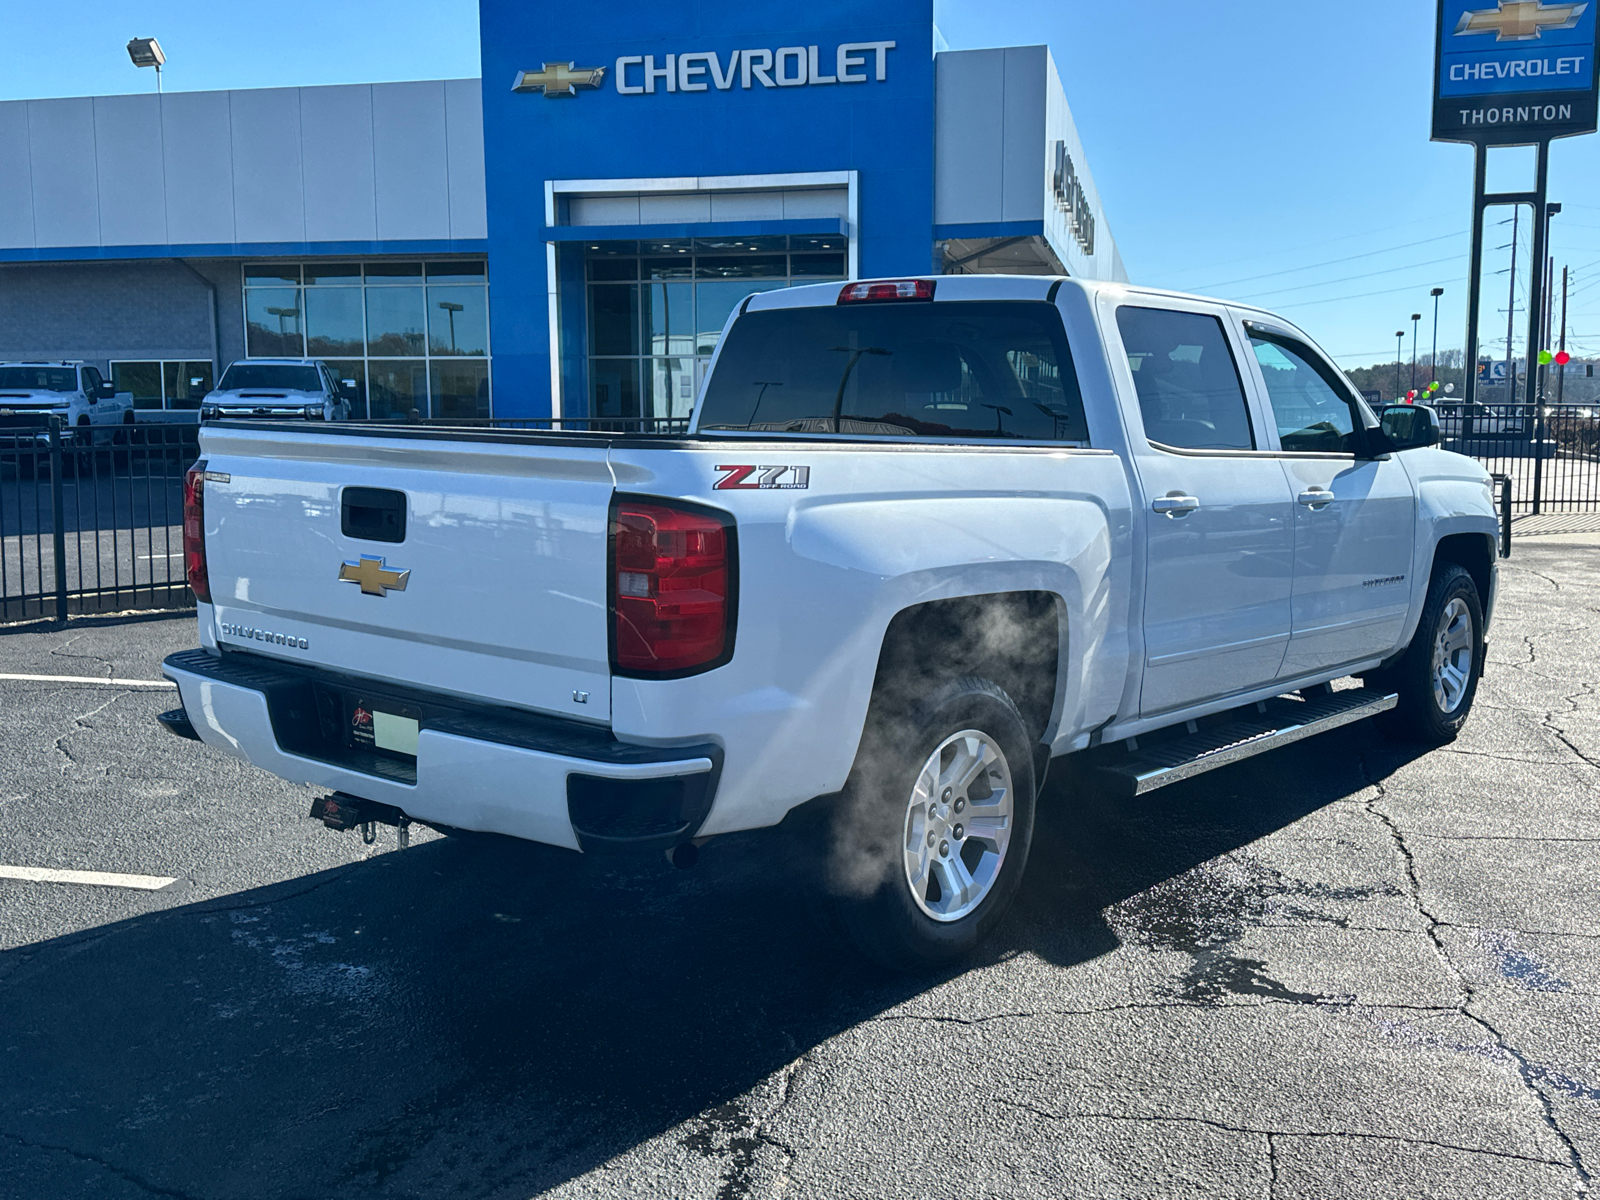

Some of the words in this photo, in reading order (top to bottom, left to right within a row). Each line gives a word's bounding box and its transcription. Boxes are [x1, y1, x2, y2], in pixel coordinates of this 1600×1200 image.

[615, 40, 897, 95] CHEVROLET
[1449, 56, 1585, 81] CHEVROLET
[1459, 104, 1572, 125] THORNTON
[712, 464, 811, 490] Z71
[221, 622, 309, 650] SILVERADO
[572, 689, 591, 704] LT
